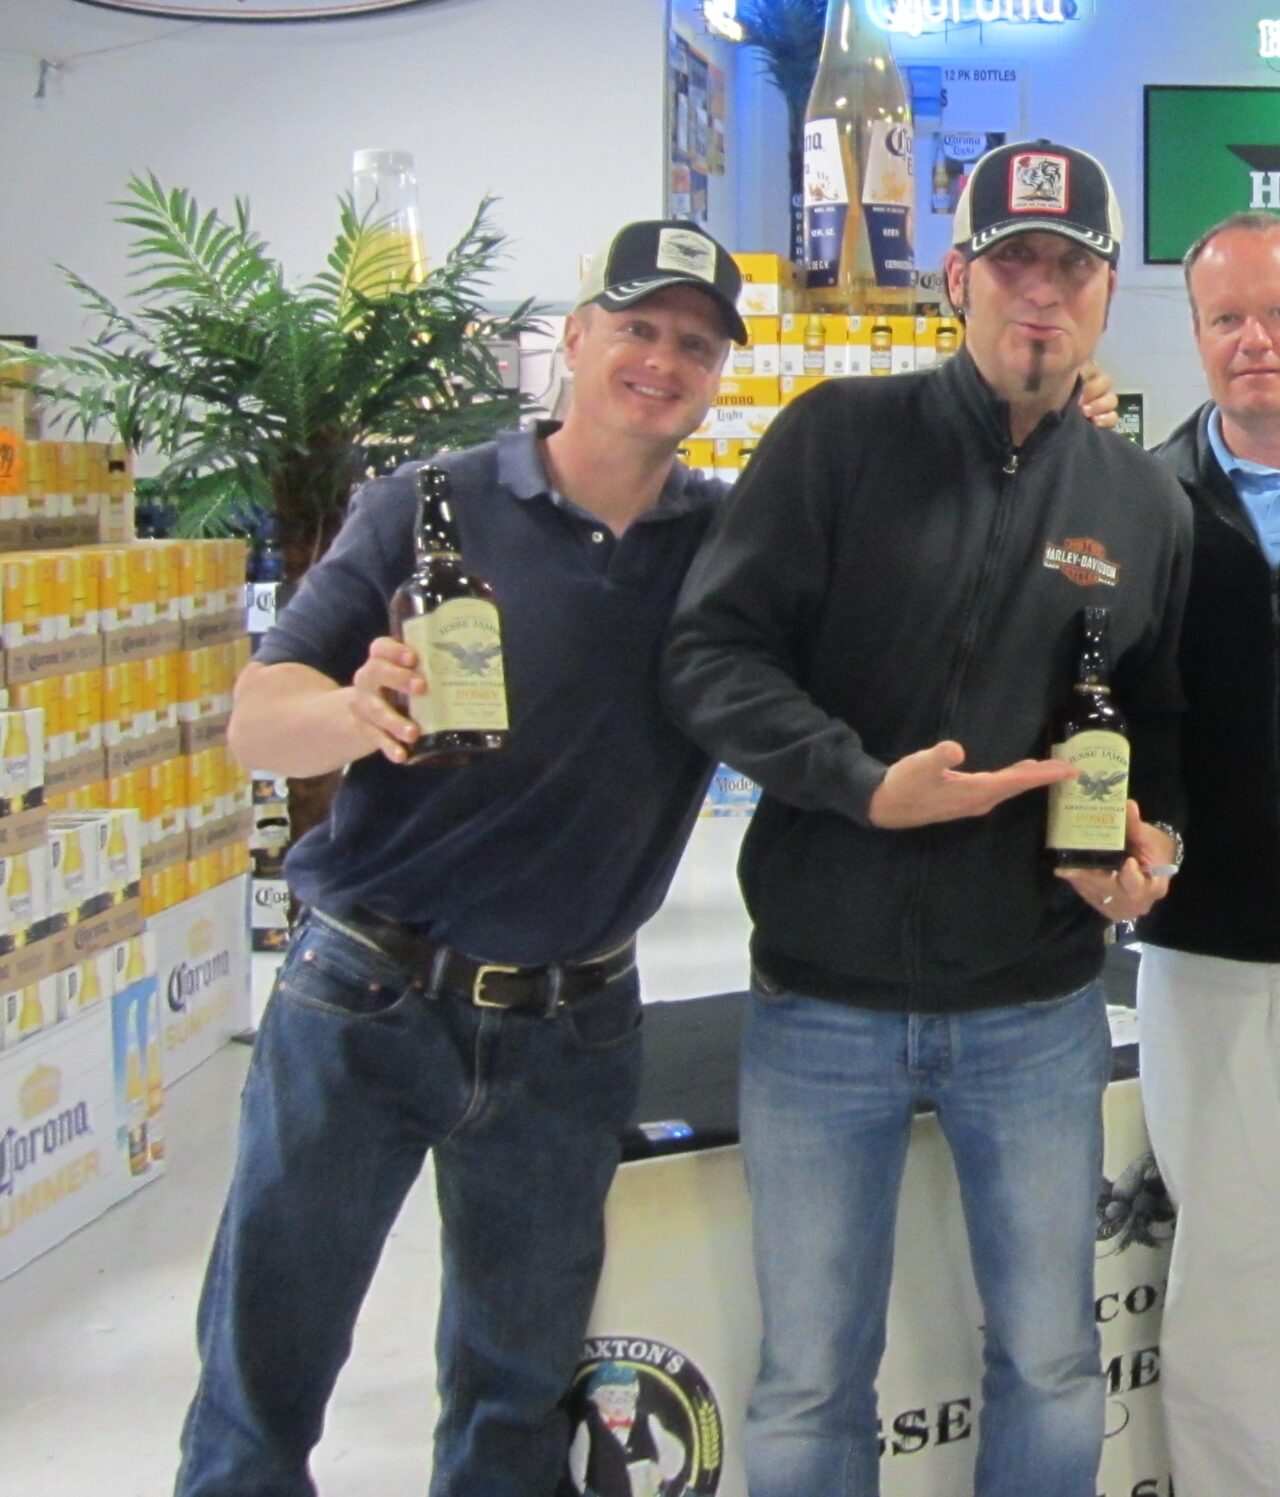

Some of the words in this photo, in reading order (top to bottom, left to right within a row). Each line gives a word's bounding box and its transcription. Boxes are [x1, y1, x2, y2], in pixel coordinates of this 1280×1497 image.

[945, 70, 955, 81] 12
[958, 70, 971, 81] PK
[974, 70, 1016, 81] BOTTLES
[944, 135, 981, 147] Corona
[716, 396, 753, 405] orona
[716, 409, 743, 422] Light
[1045, 547, 1117, 579] HARLEY-DAVIDSON
[168, 950, 230, 1013] Corona
[0, 1149, 99, 1238] UMMER
[583, 1340, 685, 1374] AXTON'S
